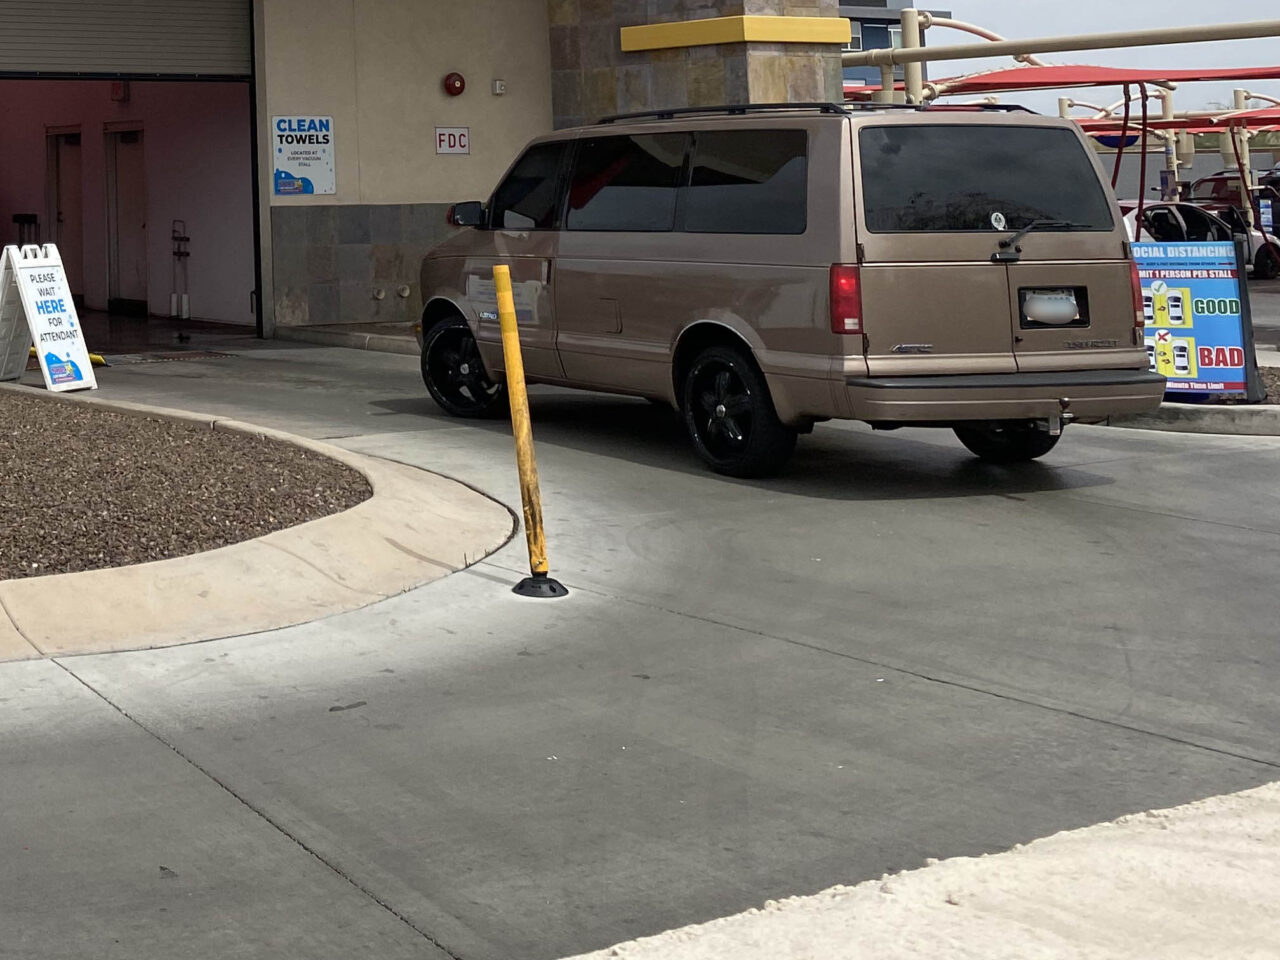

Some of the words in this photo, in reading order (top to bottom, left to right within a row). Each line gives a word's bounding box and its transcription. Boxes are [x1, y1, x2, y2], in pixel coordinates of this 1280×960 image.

[276, 118, 330, 132] CLEAN
[277, 134, 330, 145] TOWELS
[438, 133, 466, 149] FDC
[1167, 245, 1236, 258] DISTANCING
[29, 272, 57, 283] PLEASE
[1154, 270, 1160, 278] 1
[1160, 270, 1192, 278] PERSON
[1192, 270, 1209, 278] PER
[1209, 270, 1233, 278] STALL
[37, 286, 56, 297] WAIT
[35, 298, 67, 315] HERE
[1194, 299, 1241, 315] GOOD
[47, 317, 63, 327] FOR
[40, 329, 79, 342] ATTENDANT
[1199, 347, 1245, 368] BAD
